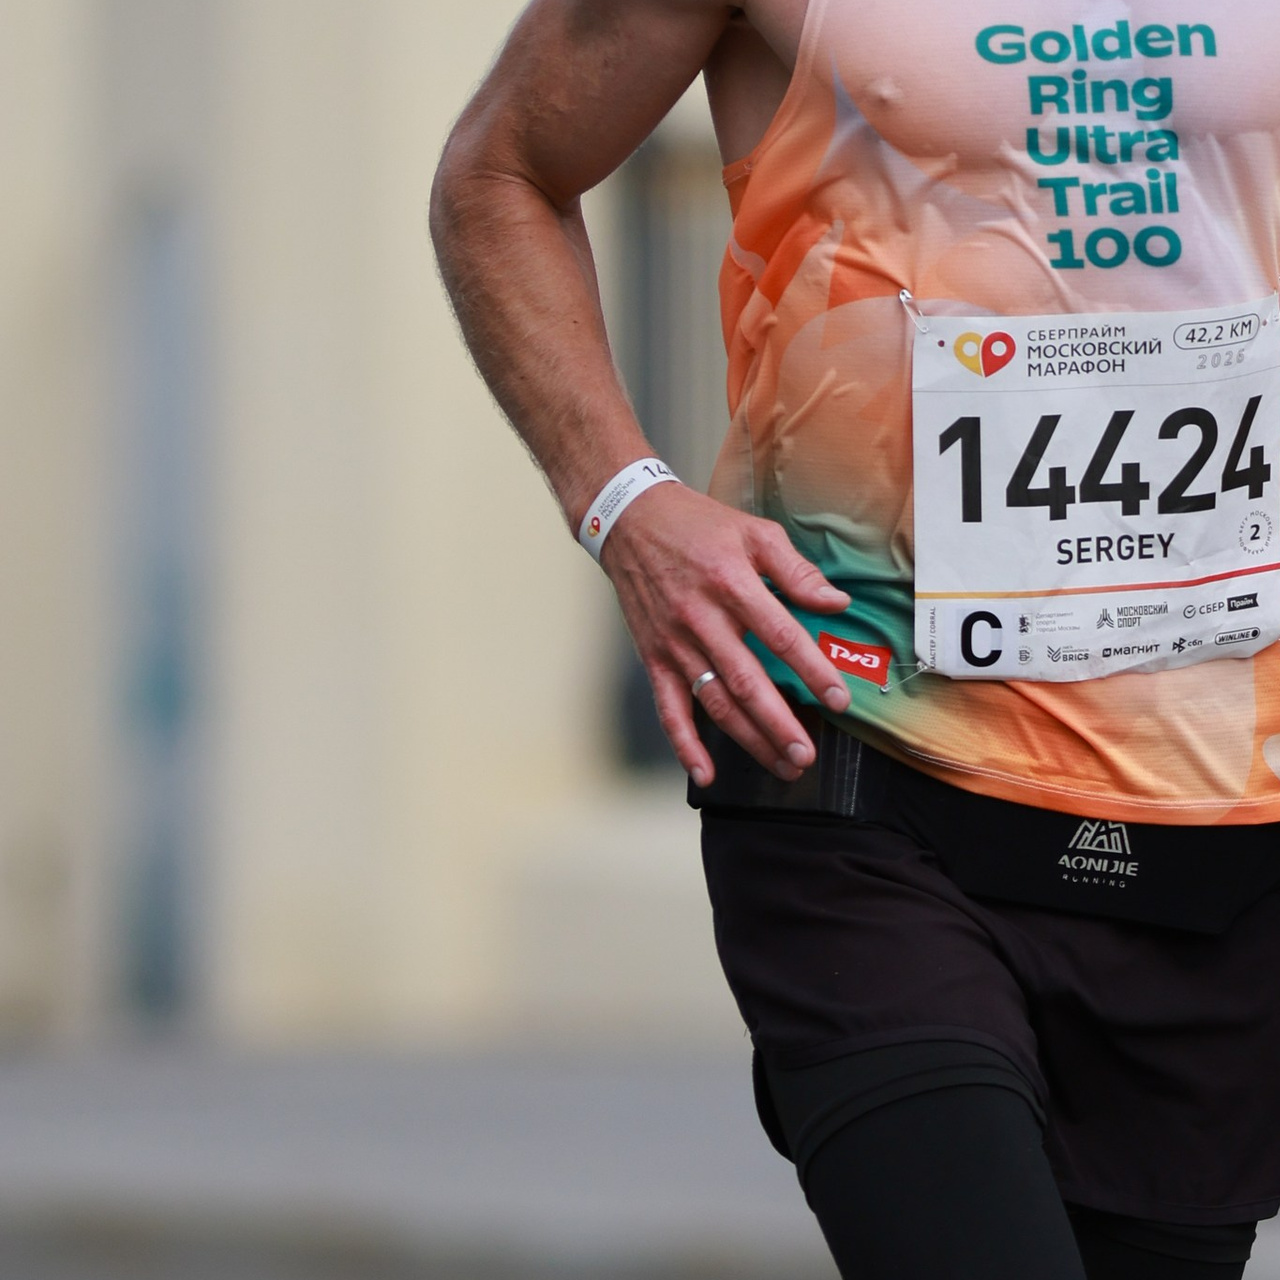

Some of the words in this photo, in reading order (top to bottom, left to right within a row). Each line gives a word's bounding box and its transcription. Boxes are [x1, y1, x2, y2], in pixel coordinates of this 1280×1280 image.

[975, 19, 1217, 64] Golden
[1027, 68, 1174, 122] Ring
[1026, 124, 1179, 166] Ultra
[1037, 167, 1179, 217] Trail
[1047, 225, 1182, 269] 100
[1027, 324, 1126, 342] СБЕРПРАЙМ
[1185, 325, 1224, 344] 42,2
[1027, 337, 1162, 359] МОСКОВСКИЙ
[1027, 358, 1125, 377] МАРАФОН
[939, 394, 1271, 523] 14424
[1250, 524, 1260, 541] 2
[1056, 533, 1175, 565] SERGEY
[1117, 602, 1168, 617] МОСКОВСКИЙ
[1199, 601, 1225, 615] СБЕР
[1117, 616, 1142, 628] СПОРТ
[961, 611, 1002, 668] C
[1218, 631, 1251, 643] WINLINE
[1062, 653, 1089, 662] BRICS
[1058, 854, 1139, 877] AONIJIE
[1062, 873, 1126, 889] RUNNING
